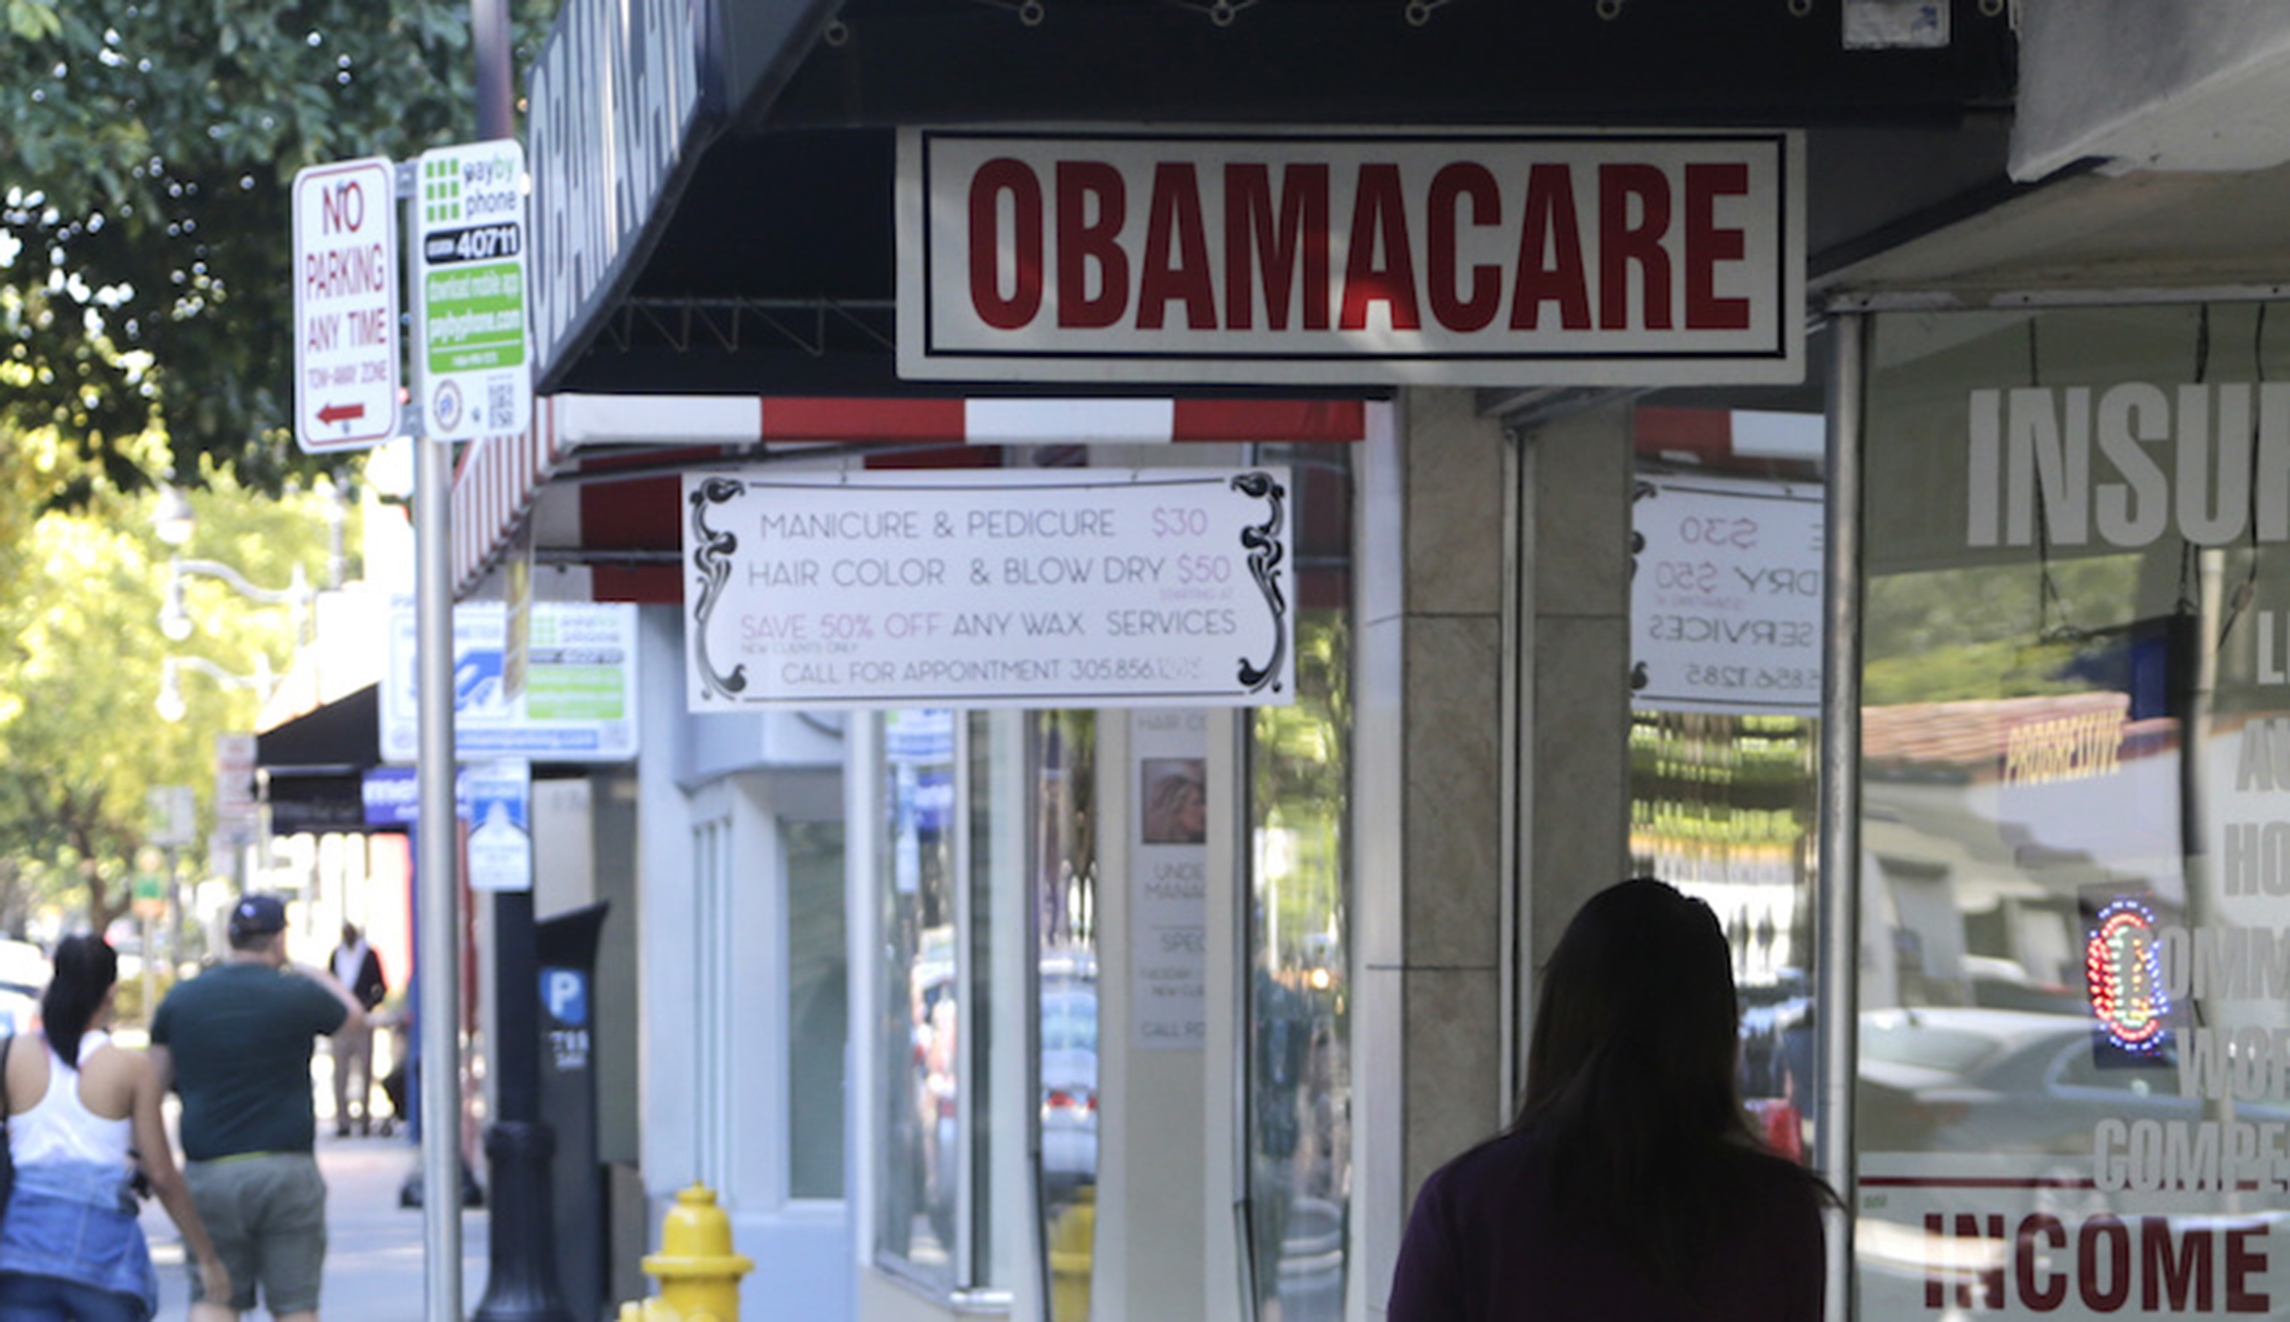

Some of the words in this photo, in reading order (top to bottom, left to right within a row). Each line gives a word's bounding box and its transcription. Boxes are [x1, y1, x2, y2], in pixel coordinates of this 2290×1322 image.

[322, 181, 364, 236] NO
[465, 189, 517, 221] phone
[457, 226, 518, 259] 40711
[967, 156, 1751, 333] OBAMACARE
[306, 243, 384, 300] PARKING
[307, 314, 341, 352] ANY
[347, 307, 387, 346] TIME
[360, 360, 388, 384] ZONE
[760, 510, 920, 539] MANICURE
[933, 510, 955, 538] &
[967, 509, 1116, 538] PEDICURE
[1152, 507, 1208, 538] $30
[748, 560, 820, 587] HAIR
[831, 558, 946, 587] COLOR
[969, 558, 991, 586] &
[1003, 555, 1094, 585] BLOW
[1103, 555, 1167, 584] DRY
[1176, 553, 1231, 584] $50
[741, 613, 807, 640] SAVE
[820, 613, 875, 640] 50%
[884, 612, 942, 640] OFF
[952, 613, 1013, 636] ANY
[1020, 612, 1086, 637] WAX
[1106, 609, 1237, 636] SERVICES
[781, 661, 842, 685] CALL
[849, 661, 895, 683] FOR
[903, 660, 1062, 682] APPOINTMENT
[551, 972, 581, 1018] P
[2094, 1117, 2290, 1193] COMPE
[1924, 1212, 2270, 1313] INCOME
